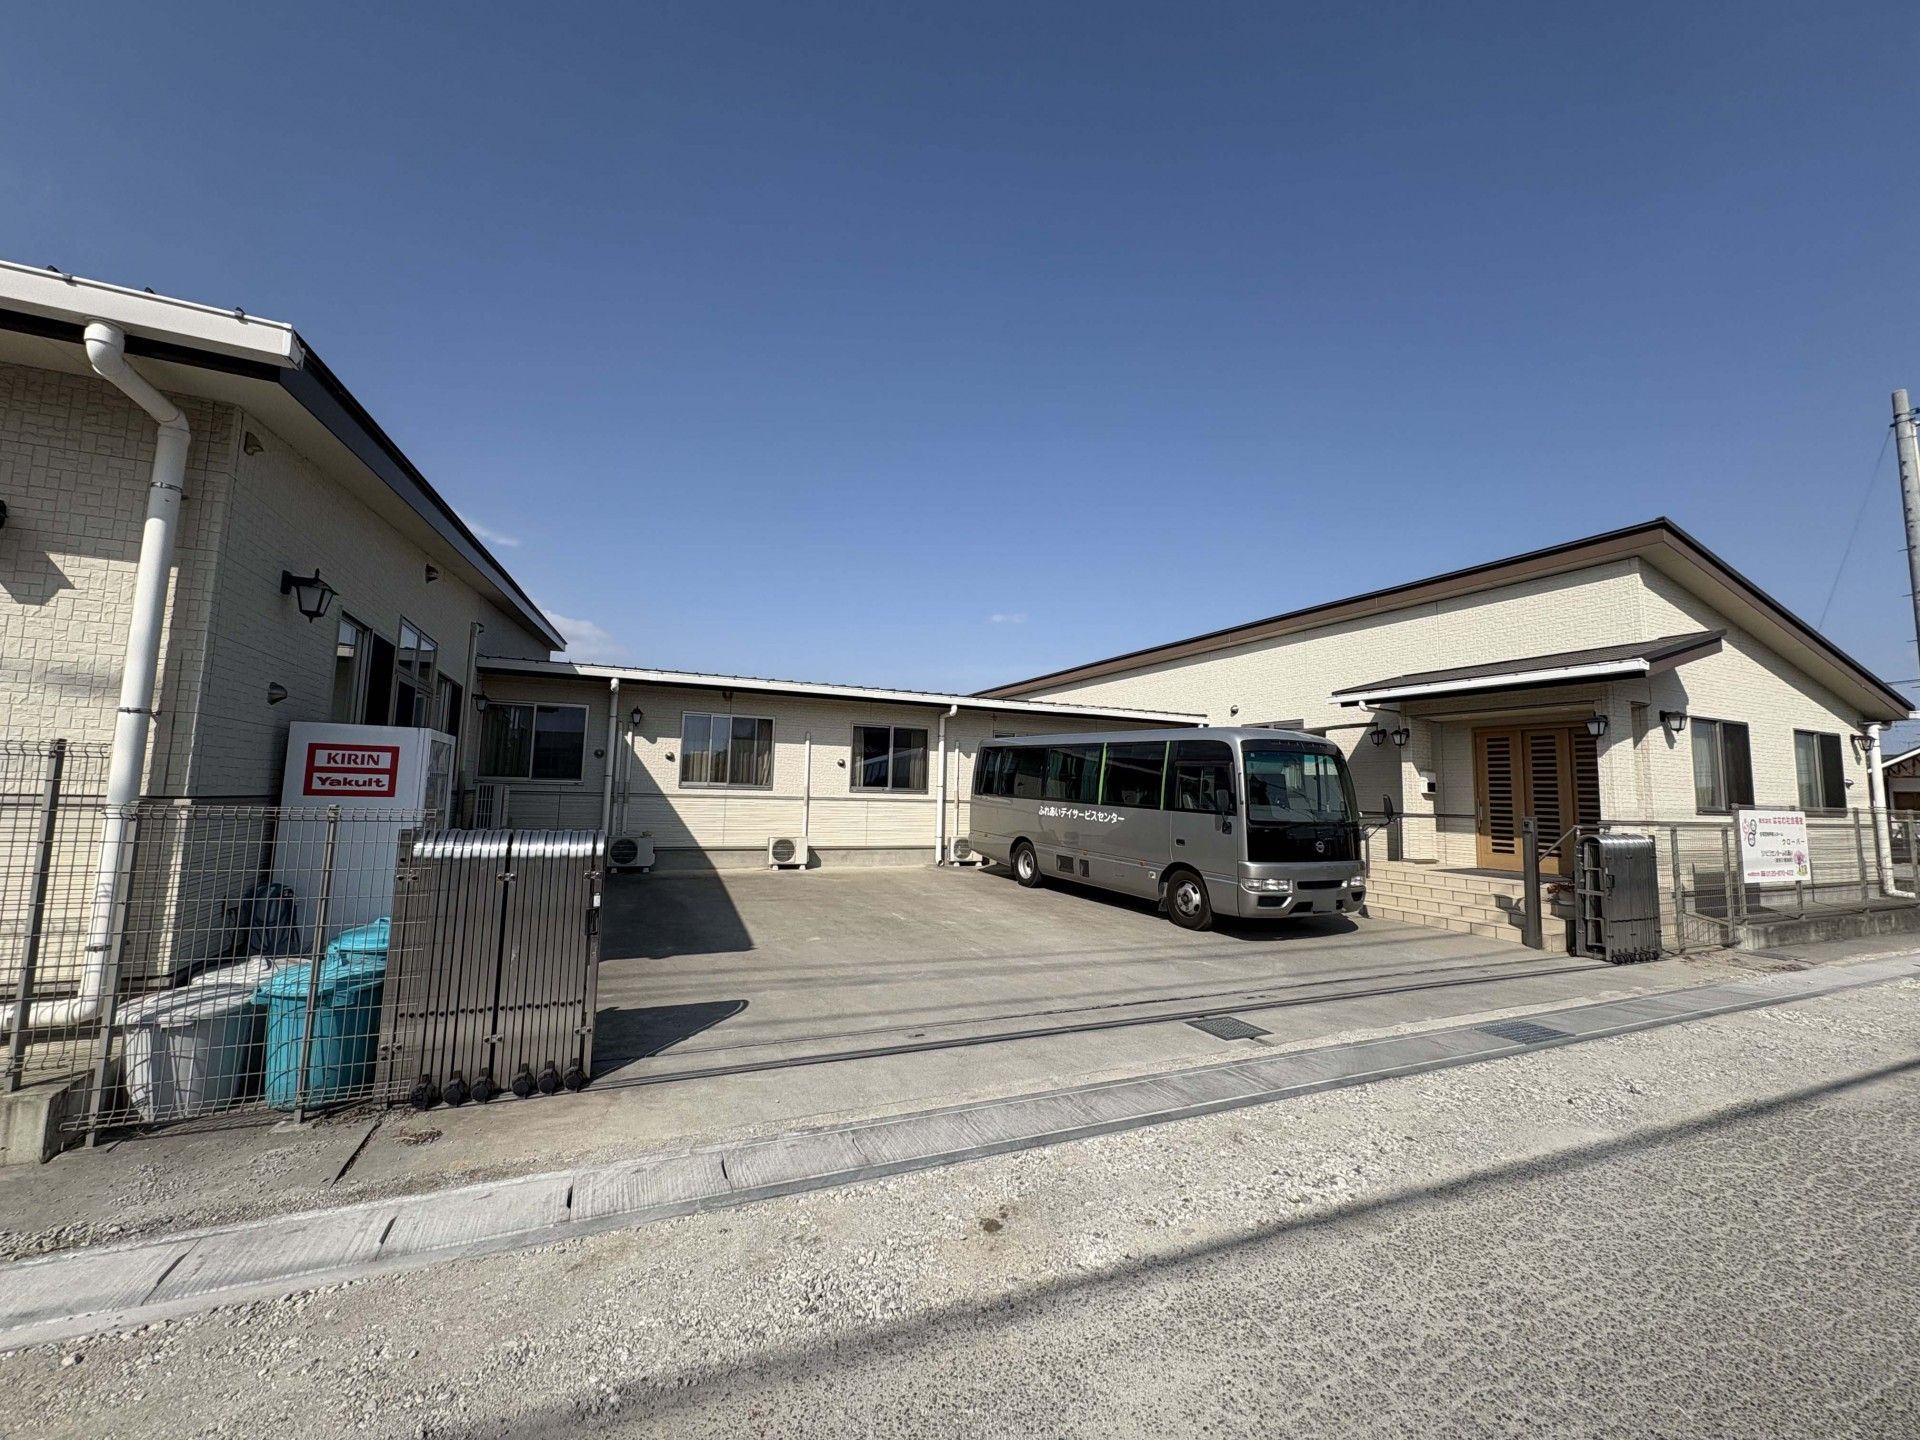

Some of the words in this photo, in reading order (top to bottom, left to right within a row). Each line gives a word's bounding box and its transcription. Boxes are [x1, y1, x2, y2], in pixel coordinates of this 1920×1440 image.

[326, 752, 380, 766] KIRIN
[316, 776, 386, 788] Yakult
[1038, 805, 1126, 824] ふれあいデイサービスセンター
